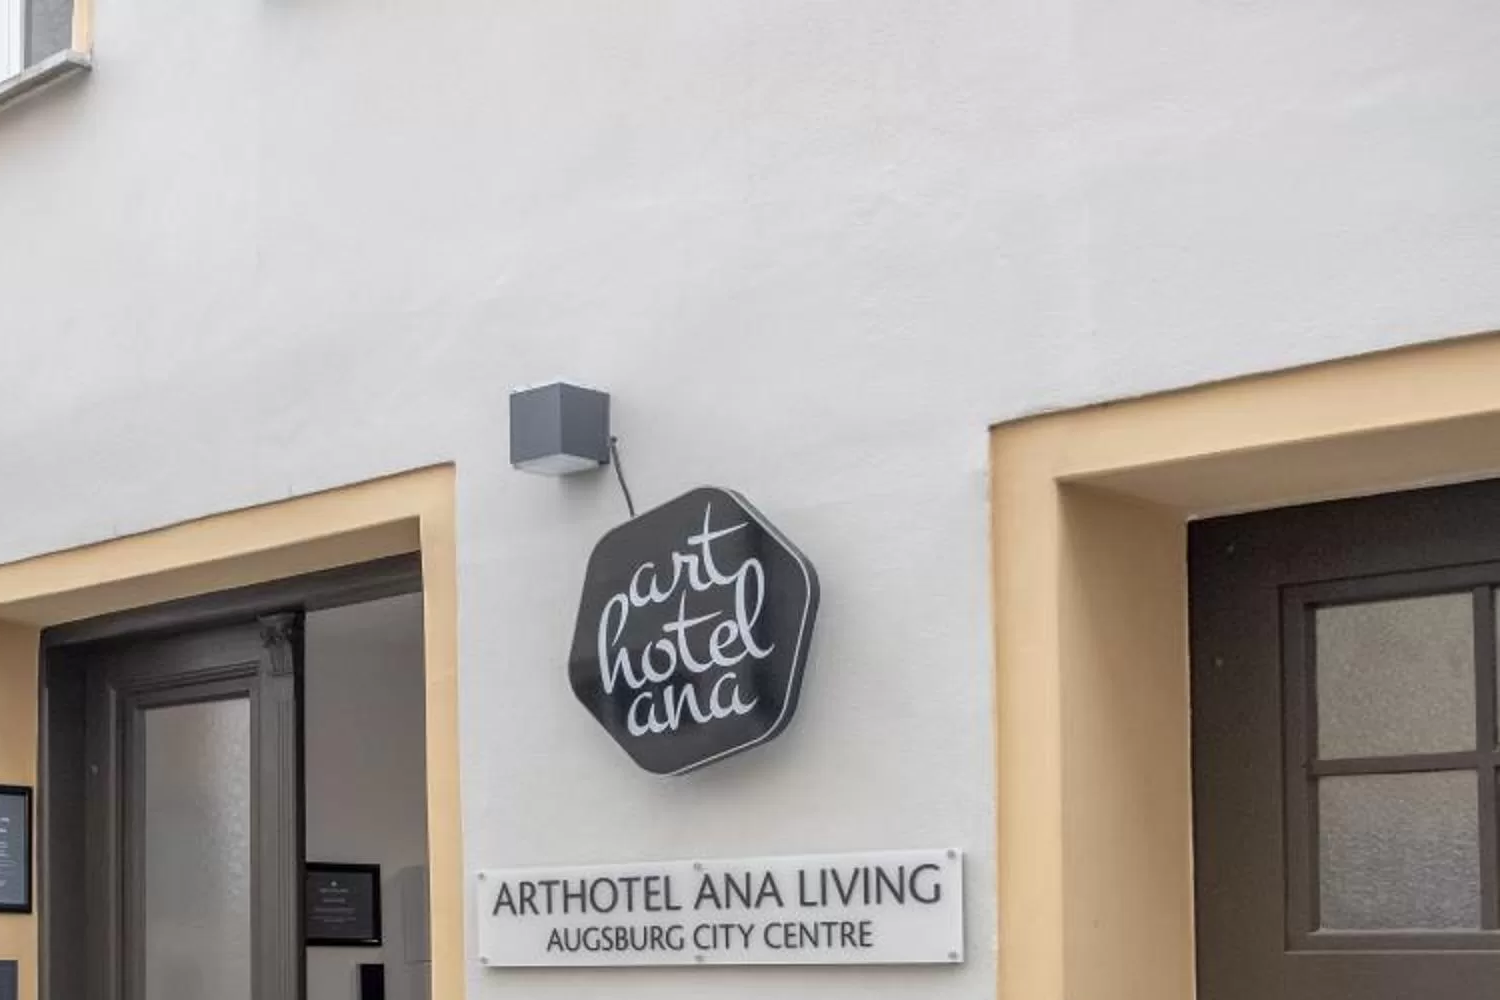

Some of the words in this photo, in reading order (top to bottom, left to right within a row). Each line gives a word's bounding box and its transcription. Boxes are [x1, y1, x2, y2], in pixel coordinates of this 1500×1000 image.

[629, 501, 748, 607] art
[598, 557, 775, 694] hotel
[627, 671, 758, 736] ana
[492, 875, 683, 917] ARTHOTEL
[693, 871, 784, 910] ANA
[798, 863, 941, 907] LIVING
[546, 924, 685, 952] AUGSBURG
[693, 923, 755, 950] CITY
[763, 920, 874, 949] CENTRE
